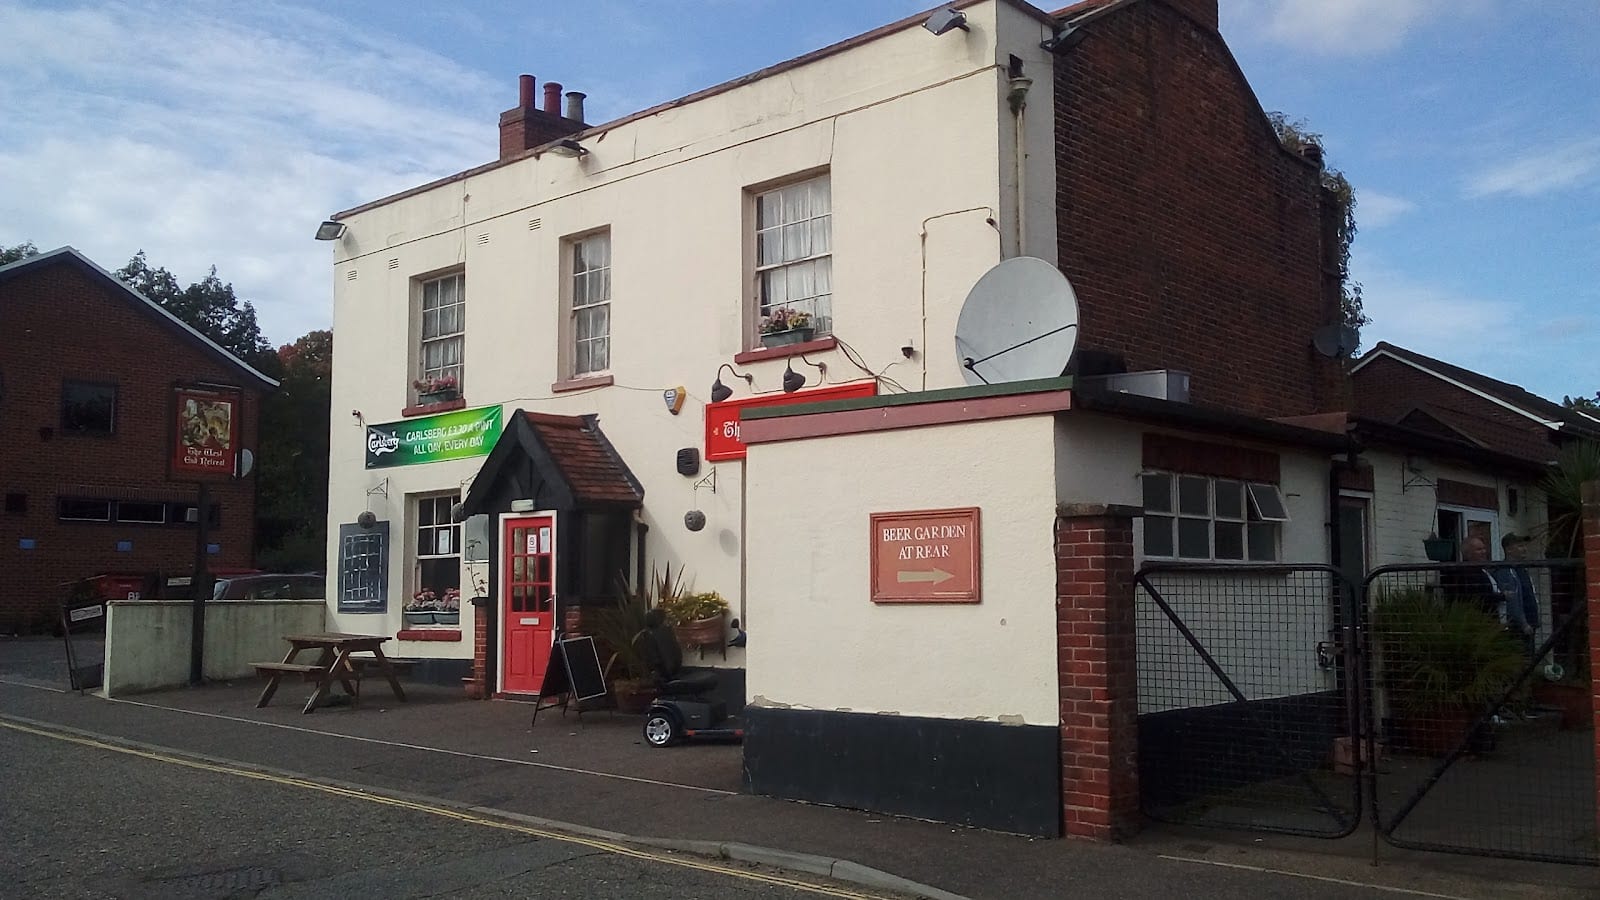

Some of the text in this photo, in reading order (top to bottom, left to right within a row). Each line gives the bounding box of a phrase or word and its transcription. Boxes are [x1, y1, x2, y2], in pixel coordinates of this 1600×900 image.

[406, 427, 447, 442] CARLSBERG
[475, 419, 494, 432] PINT
[187, 446, 223, 457] The West
[368, 431, 400, 456] Carlsberg
[413, 444, 427, 455] ALL
[444, 438, 469, 450] EVERY
[469, 435, 484, 447] DAY
[184, 456, 225, 467] End Retreat
[883, 524, 967, 541] BEER GARDEN
[898, 544, 951, 560] AT REAR
